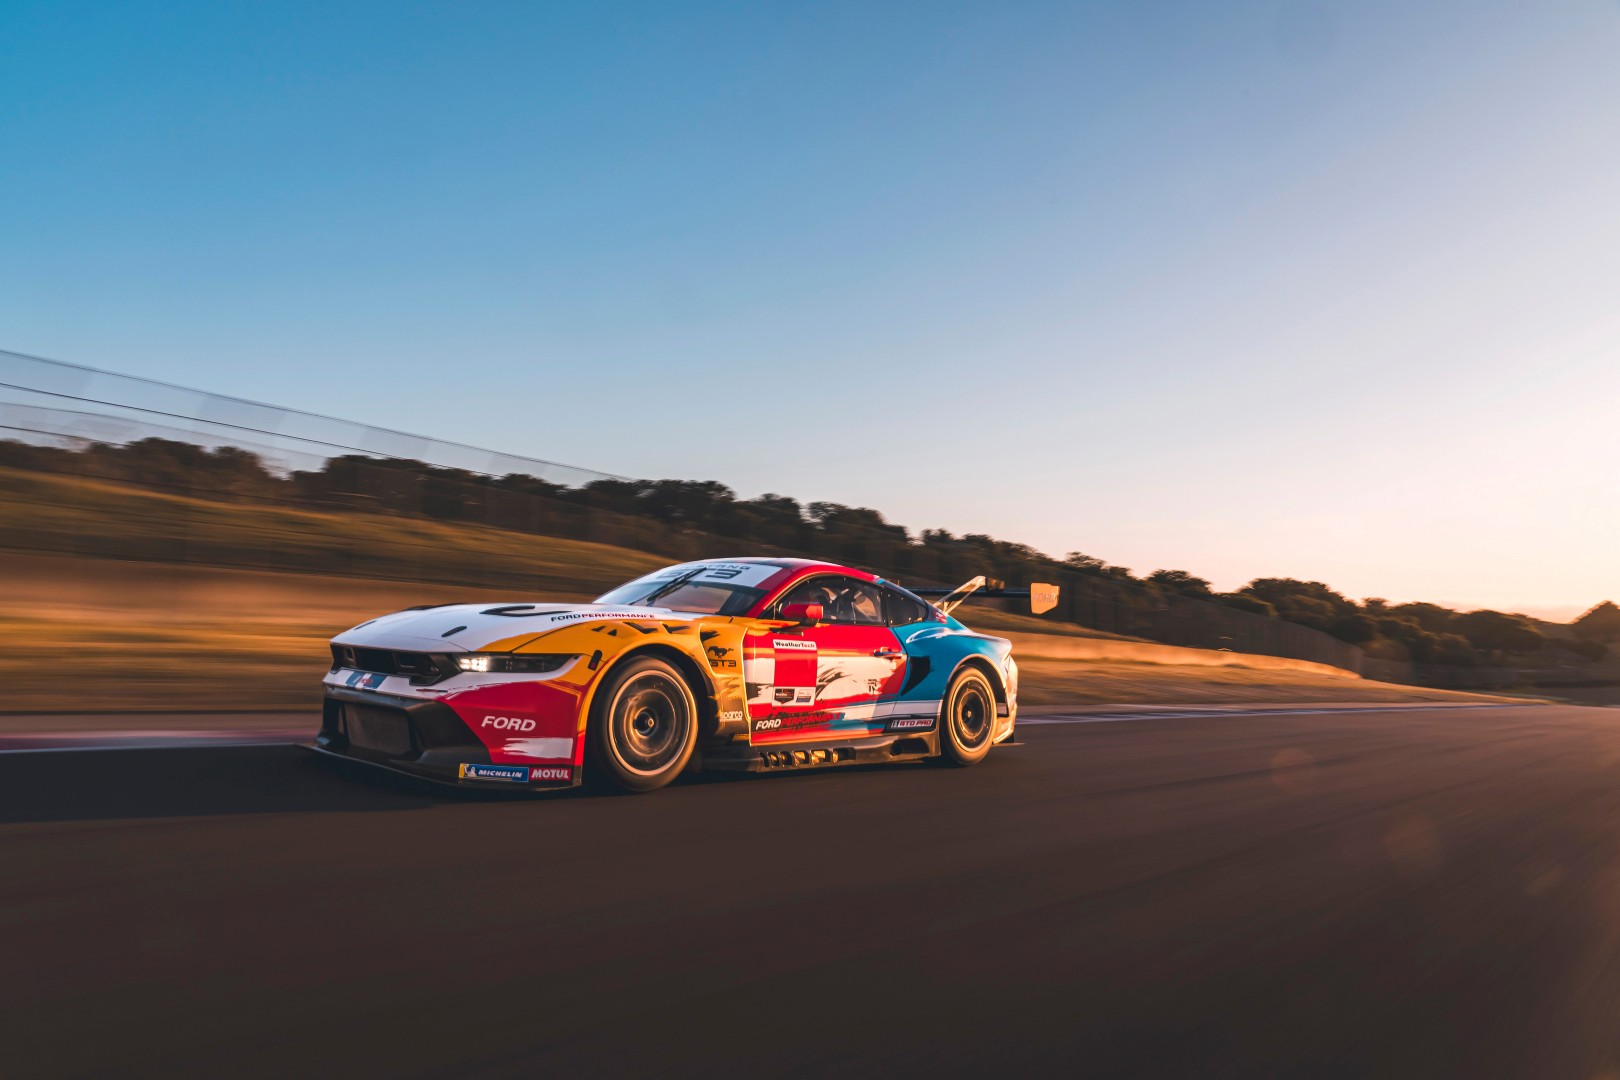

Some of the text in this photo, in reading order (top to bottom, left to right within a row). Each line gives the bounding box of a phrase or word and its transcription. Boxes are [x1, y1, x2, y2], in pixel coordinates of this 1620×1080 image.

[774, 641, 815, 649] WeatherTech
[481, 715, 536, 731] FORD
[478, 769, 523, 778] MICHELIN
[531, 769, 569, 779] MOTUL
